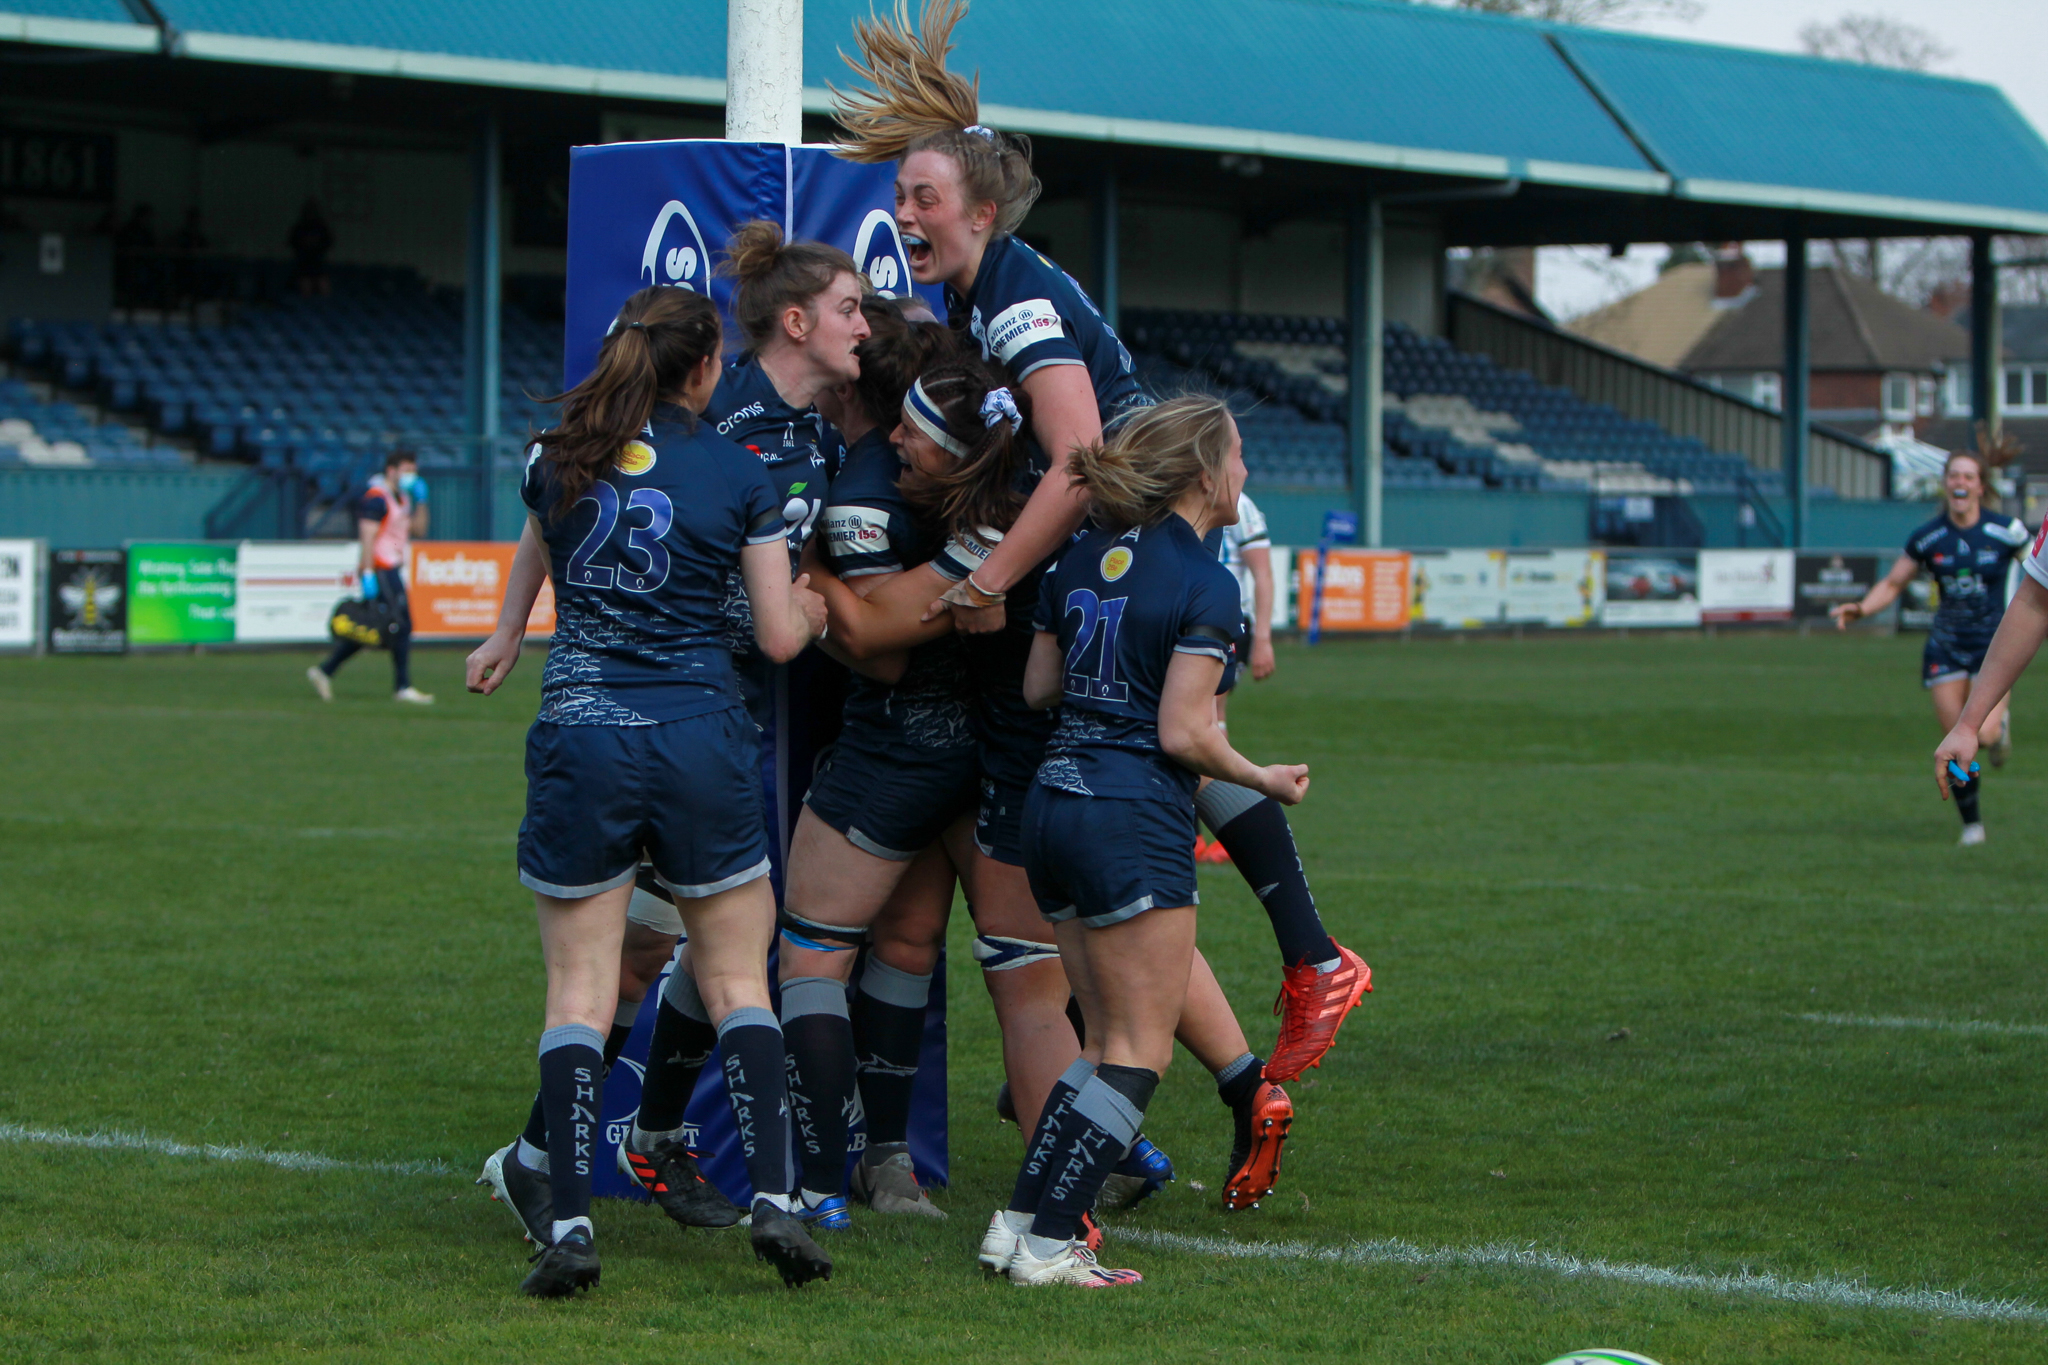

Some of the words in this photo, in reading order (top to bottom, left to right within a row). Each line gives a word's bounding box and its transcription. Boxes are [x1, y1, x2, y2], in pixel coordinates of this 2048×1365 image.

[990, 316, 1018, 343] Allianz
[992, 322, 1032, 354] PREMIER
[717, 401, 765, 435] cronis
[566, 479, 674, 593] 23
[1063, 588, 1128, 703] 21
[569, 1067, 597, 1176] SHARKS
[725, 1053, 756, 1158] SHARKS
[785, 1053, 821, 1155] SHARKS
